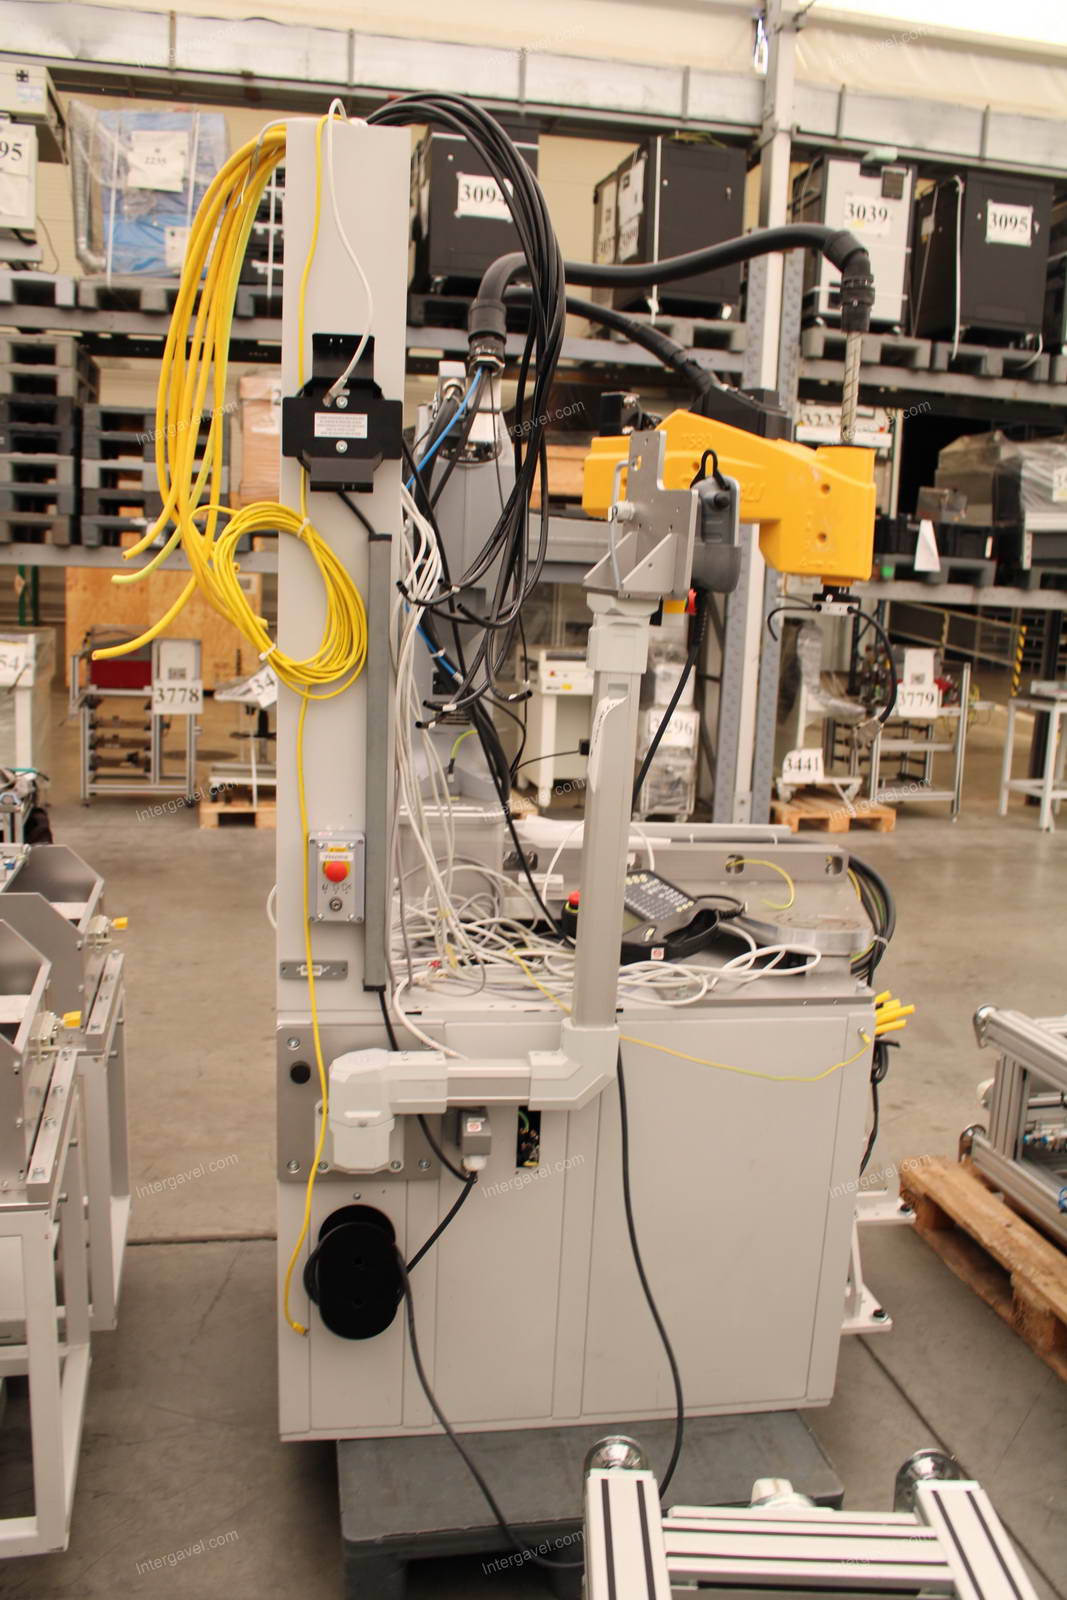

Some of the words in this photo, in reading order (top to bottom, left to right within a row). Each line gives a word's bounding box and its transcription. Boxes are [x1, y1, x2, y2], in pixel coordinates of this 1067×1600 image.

[847, 202, 888, 225] 3039
[989, 211, 1028, 233] 3095
[803, 412, 841, 427] 323
[155, 687, 200, 704] 3778
[898, 690, 935, 707] 3779
[784, 755, 819, 774] 3441
